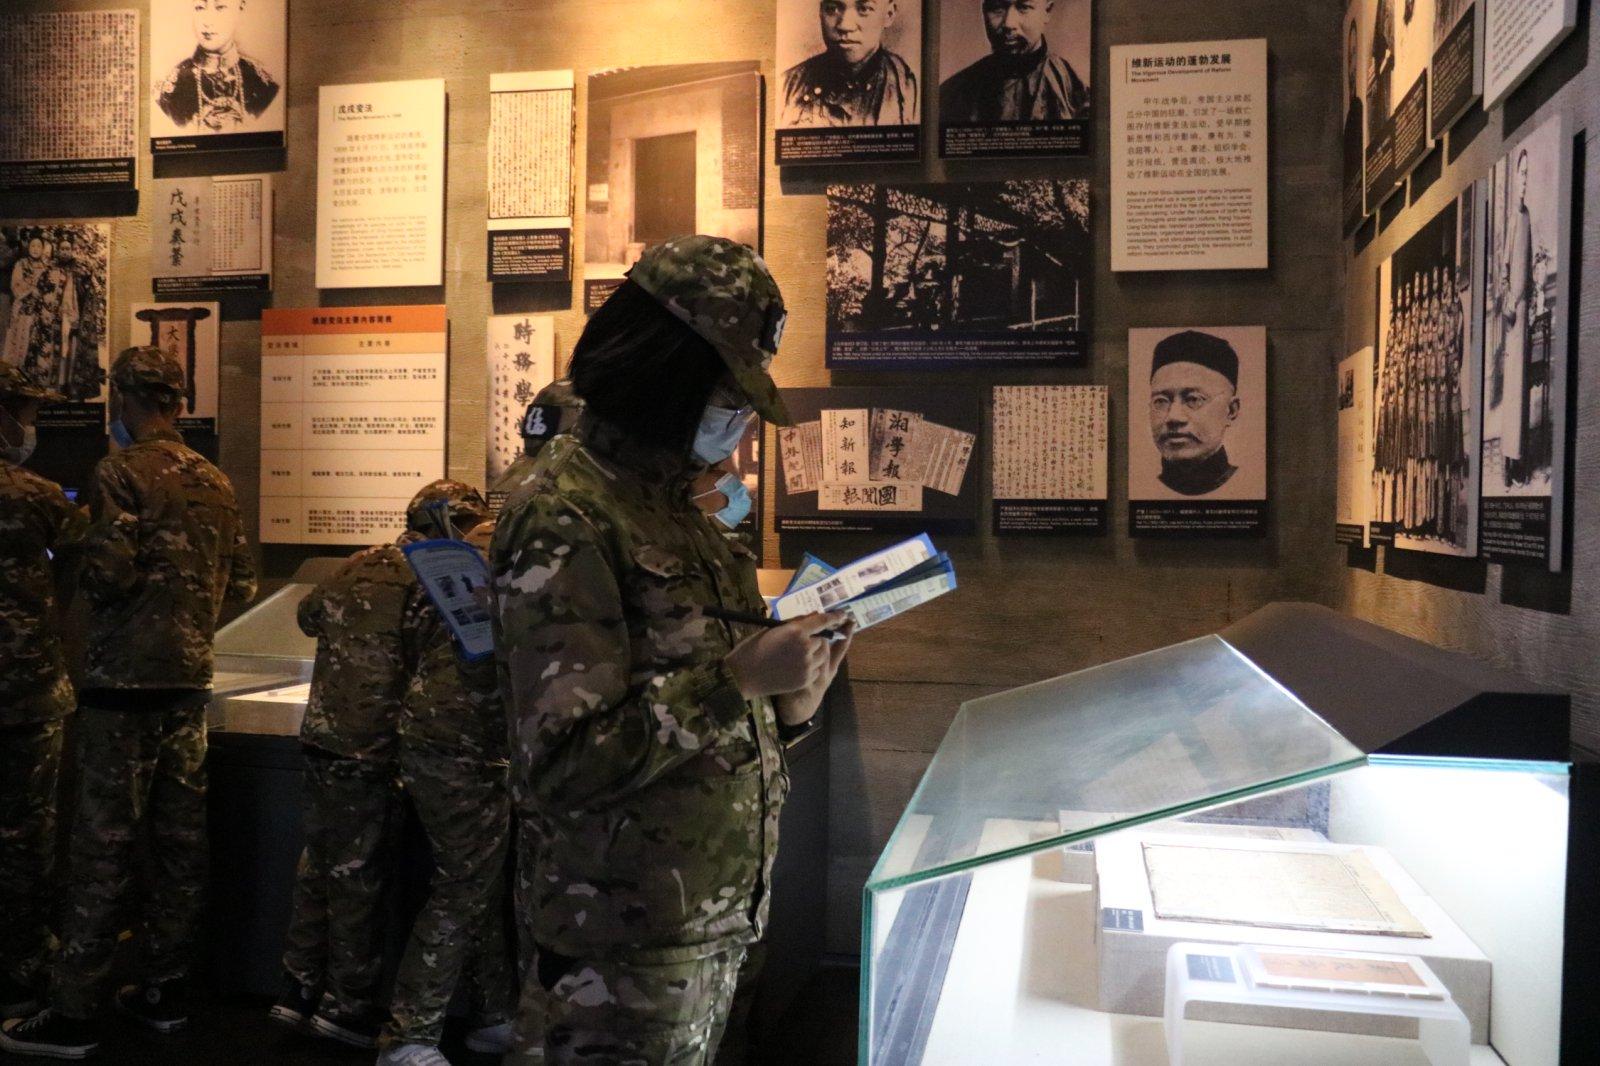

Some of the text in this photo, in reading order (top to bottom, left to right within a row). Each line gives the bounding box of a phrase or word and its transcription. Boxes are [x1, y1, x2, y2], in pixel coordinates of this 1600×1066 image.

[1131, 53, 1231, 68] 维新运动的蓬勃发展
